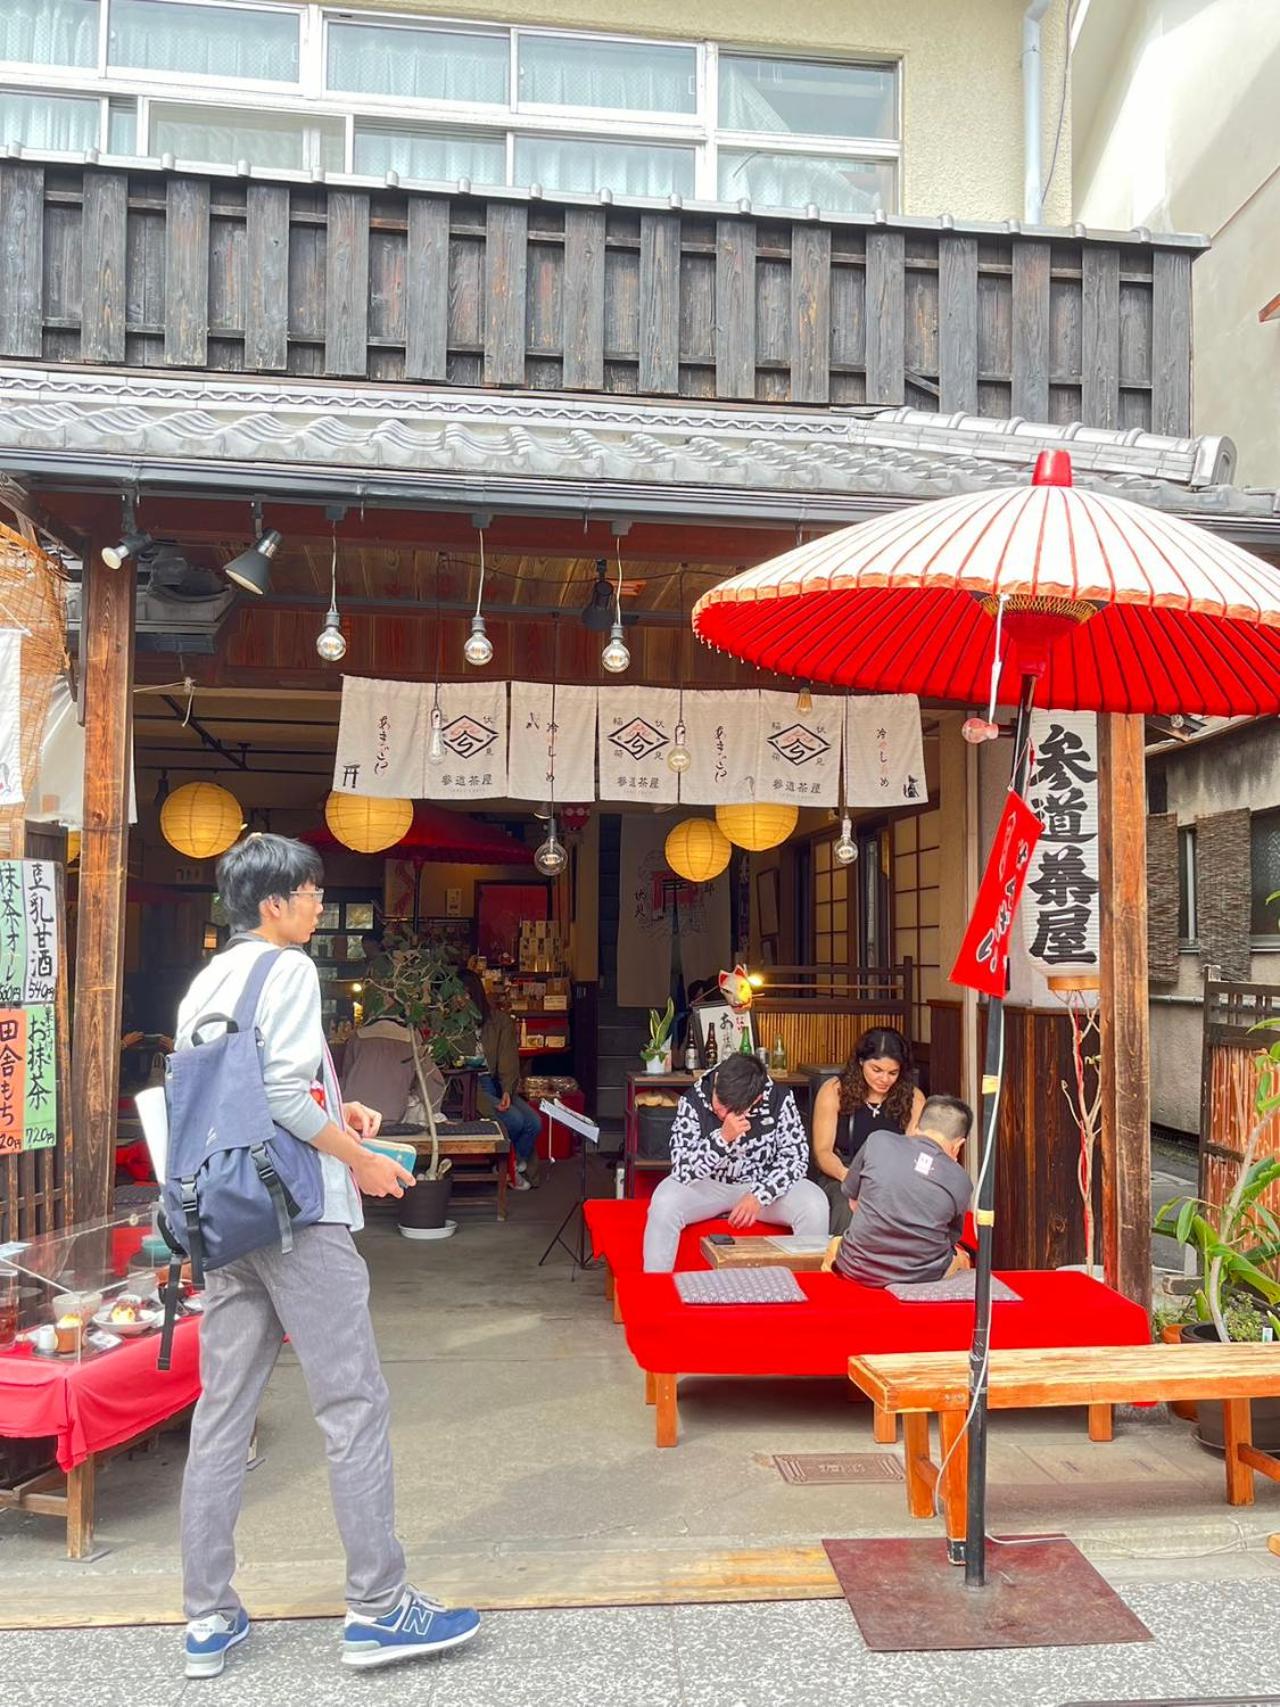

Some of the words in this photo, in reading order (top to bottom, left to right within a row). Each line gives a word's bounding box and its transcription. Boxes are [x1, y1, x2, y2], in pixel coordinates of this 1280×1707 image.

[1029, 723, 1099, 965] 参道茶屋
[28, 863, 54, 977] 豆乳甘酒
[28, 978, 55, 999] 540円
[0, 1019, 22, 1127] 田舎もち
[26, 1014, 51, 1111] お抹茶
[26, 1127, 55, 1145] 720円
[401, 1605, 434, 1637] N
